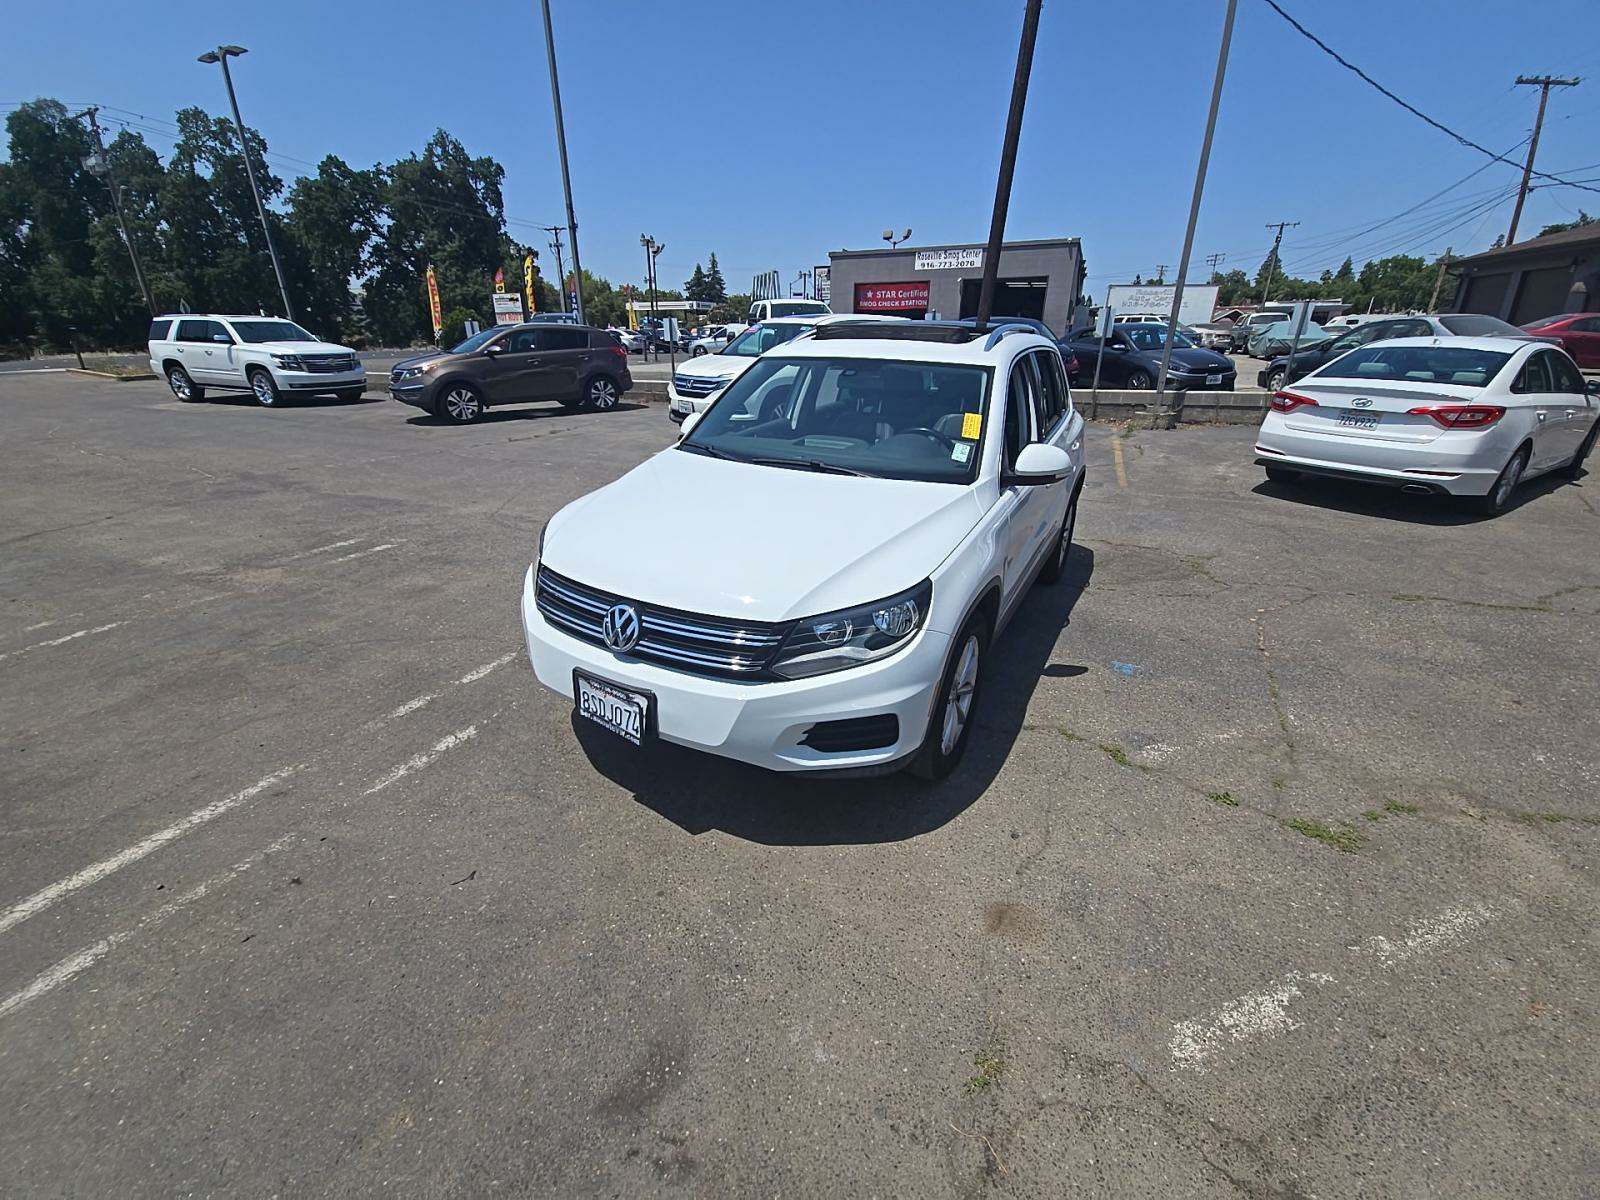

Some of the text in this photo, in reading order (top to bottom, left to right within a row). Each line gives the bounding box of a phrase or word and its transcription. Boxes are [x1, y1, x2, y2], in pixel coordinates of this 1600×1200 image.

[917, 249, 981, 261] Roseville Smog Center
[428, 274, 441, 327] OPEN
[876, 289, 928, 298] STAR Certified
[582, 690, 639, 735] 8SDJ074
